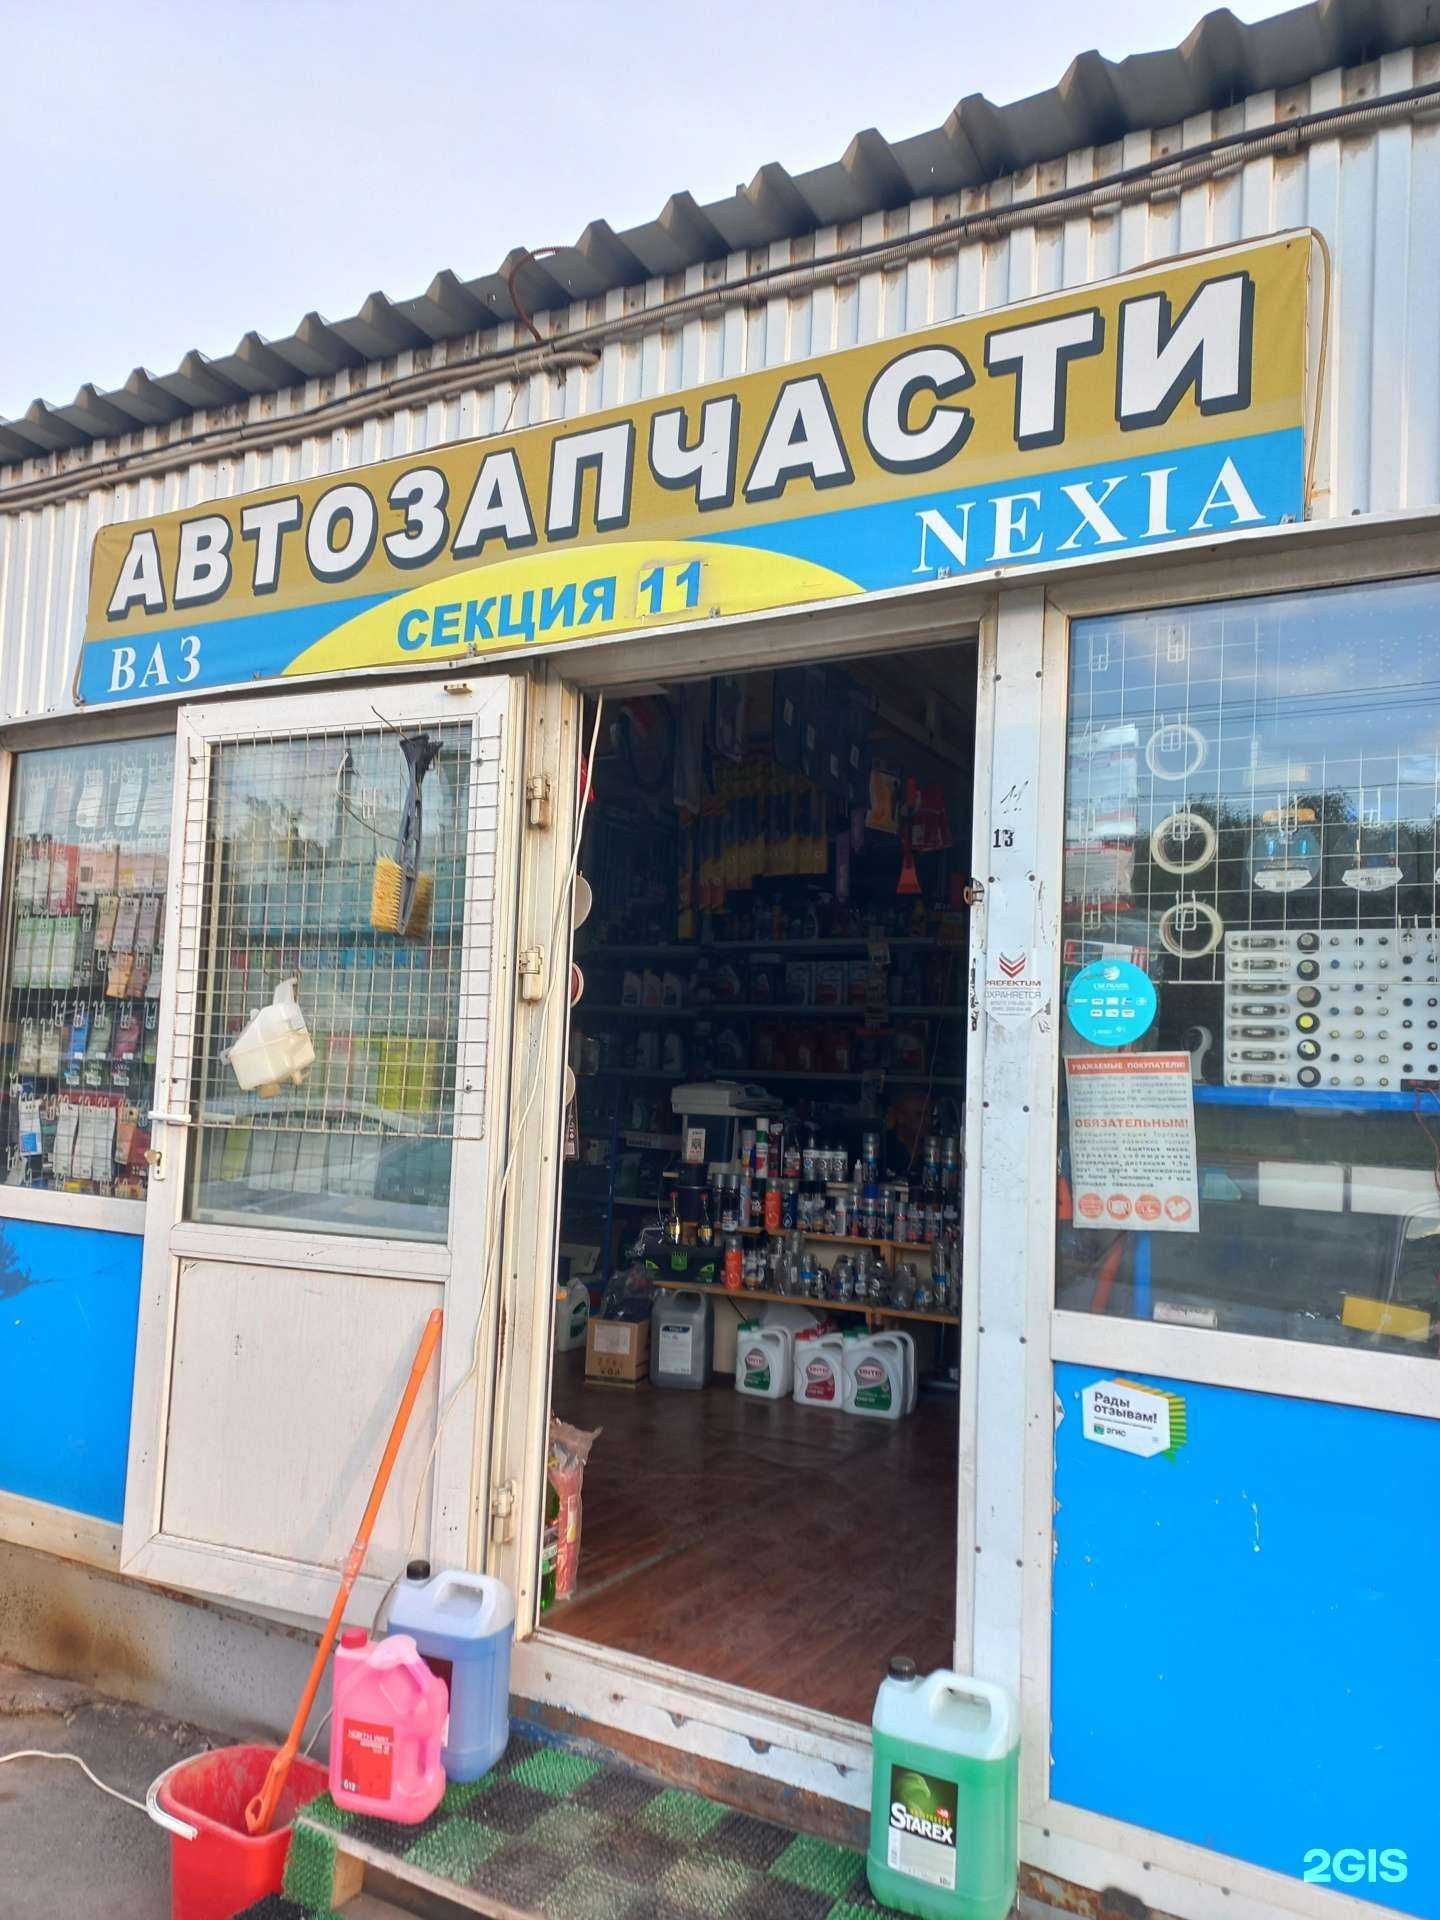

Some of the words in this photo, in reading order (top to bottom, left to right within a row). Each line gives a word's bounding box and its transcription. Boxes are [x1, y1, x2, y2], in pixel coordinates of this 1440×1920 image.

[106, 271, 1256, 621] АВТОЗАПЧАСТИ
[911, 456, 1266, 575] NEXIA
[396, 576, 617, 652] СЕКЦИЯ
[640, 558, 700, 614] 11
[107, 634, 202, 694] ВАЗ
[993, 828, 1015, 848] 13
[1074, 1118, 1189, 1129] ОБЯЗАТЕЛЬНЫМ!
[1093, 1404, 1158, 1424] отзывам!
[1094, 1391, 1130, 1409] Рады
[890, 1802, 953, 1844] STAREX
